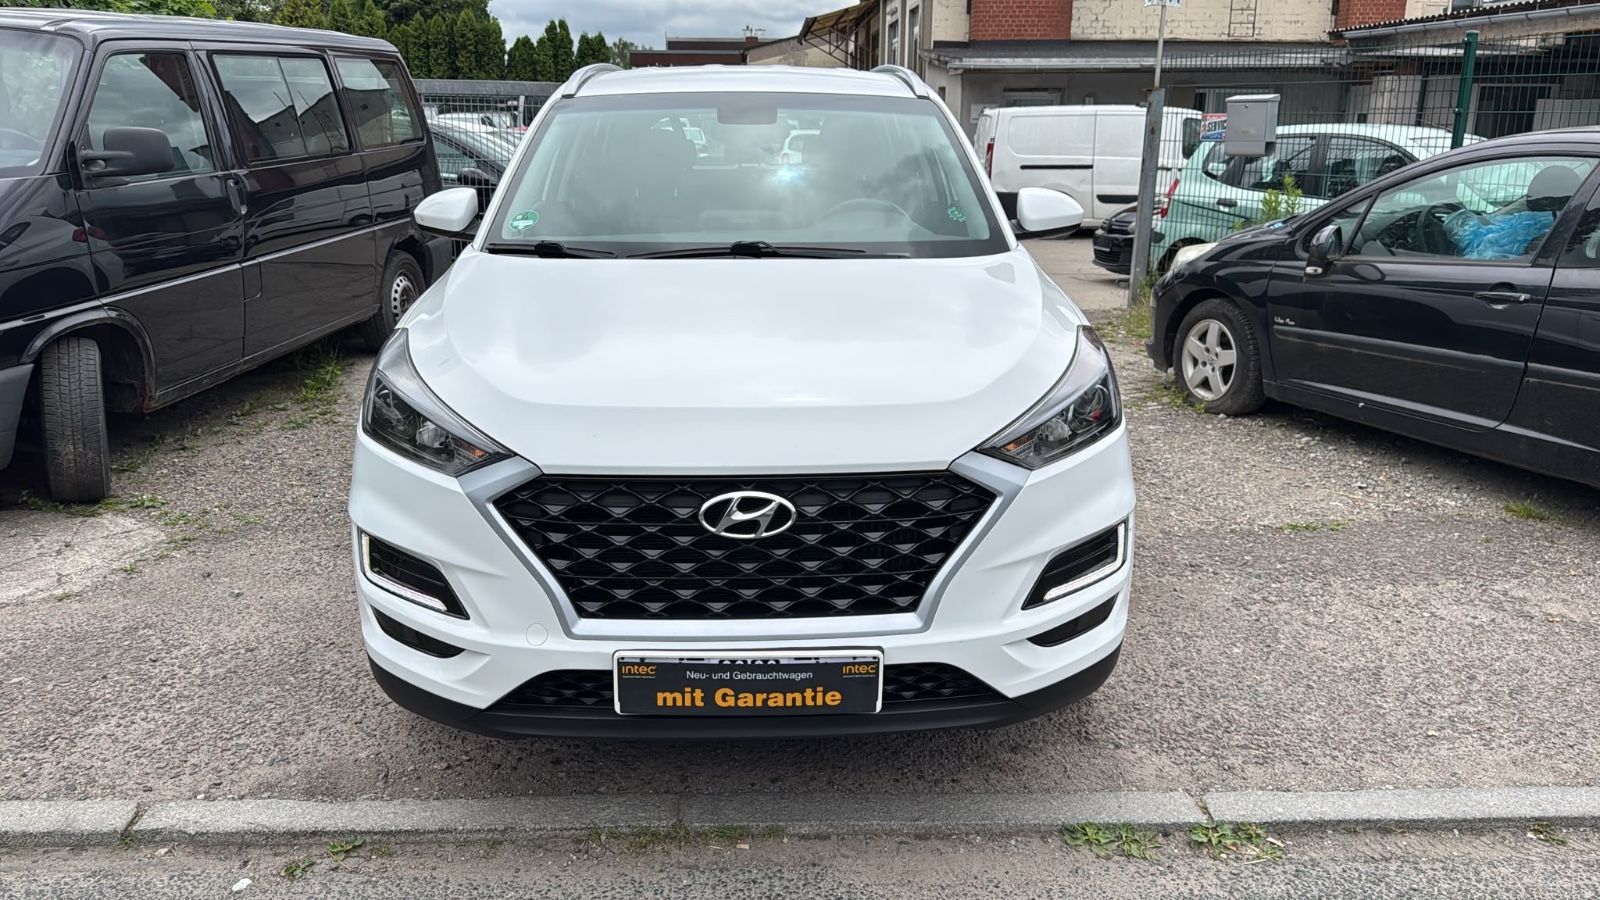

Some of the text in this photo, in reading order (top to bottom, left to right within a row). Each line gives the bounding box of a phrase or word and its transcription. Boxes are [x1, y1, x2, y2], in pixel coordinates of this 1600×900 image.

[622, 664, 656, 675] intec
[842, 663, 877, 674] intec
[686, 670, 813, 682] Neu- und Gebrauchtwagen
[656, 686, 842, 707] mit Garantie
